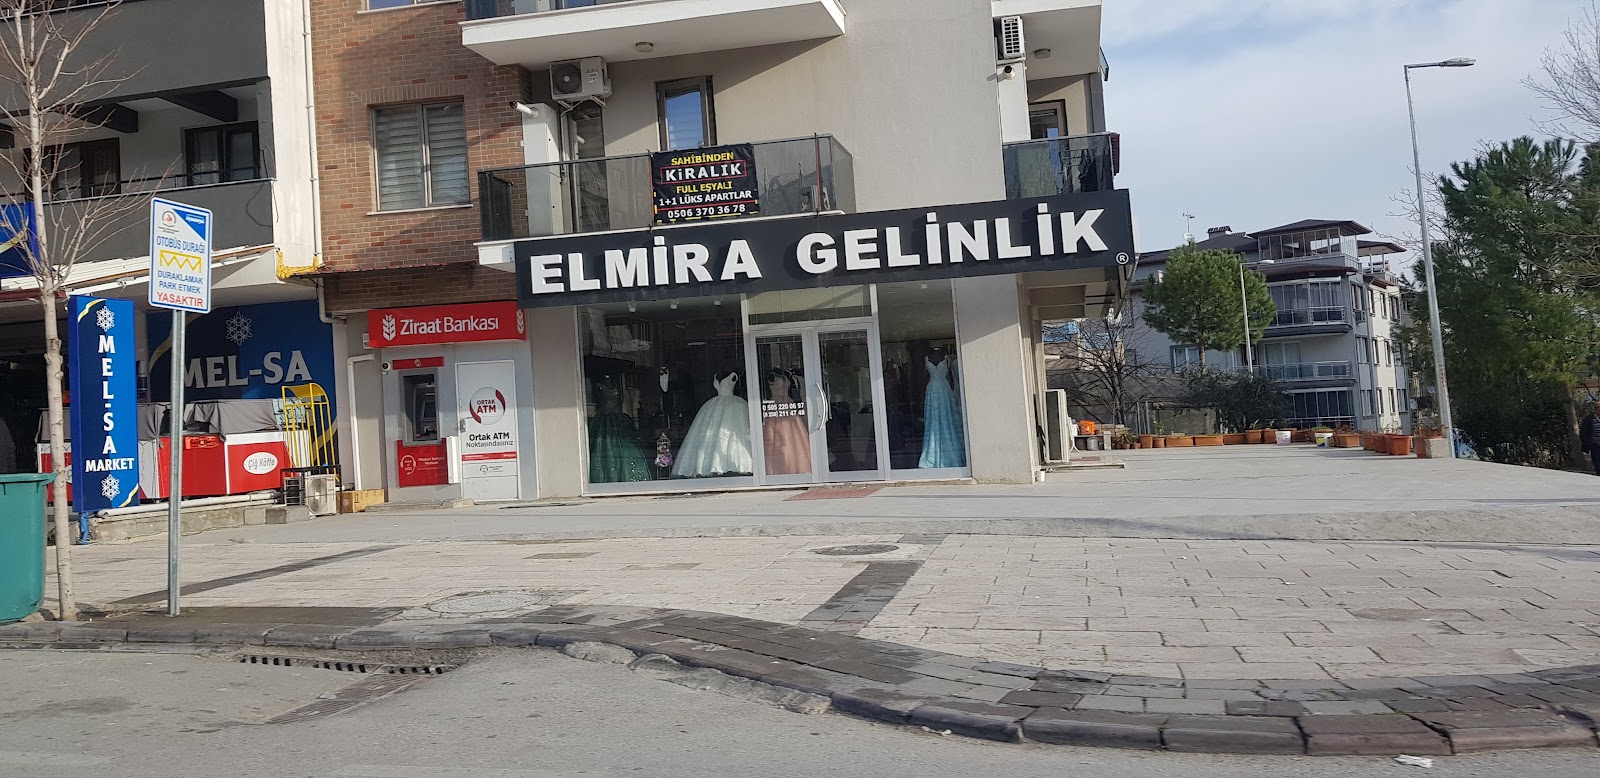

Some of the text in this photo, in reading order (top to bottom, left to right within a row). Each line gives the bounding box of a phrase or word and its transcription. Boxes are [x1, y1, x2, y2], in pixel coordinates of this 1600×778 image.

[671, 152, 734, 166] SAHİBİNDEN
[676, 181, 733, 194] FULL EŞYALI
[659, 190, 752, 206] 1+1 LÜKS APARTLAR
[667, 204, 746, 218] 0506 370 36 78
[156, 235, 206, 254] OTOBÜS DURAĞI
[530, 203, 1109, 294] ELMİRA GELİNLİK
[157, 270, 204, 285] DURAKLAMAK
[159, 280, 201, 294] PARK ETMEK
[156, 291, 204, 308] YASAKTIR
[400, 315, 499, 336] Ziraat Bankası
[98, 335, 117, 454] MEL-SA
[476, 405, 497, 414] ATM
[466, 440, 514, 448] Noktasındasınız
[469, 432, 510, 441] Ortak ATM
[85, 457, 135, 473] MARKET
